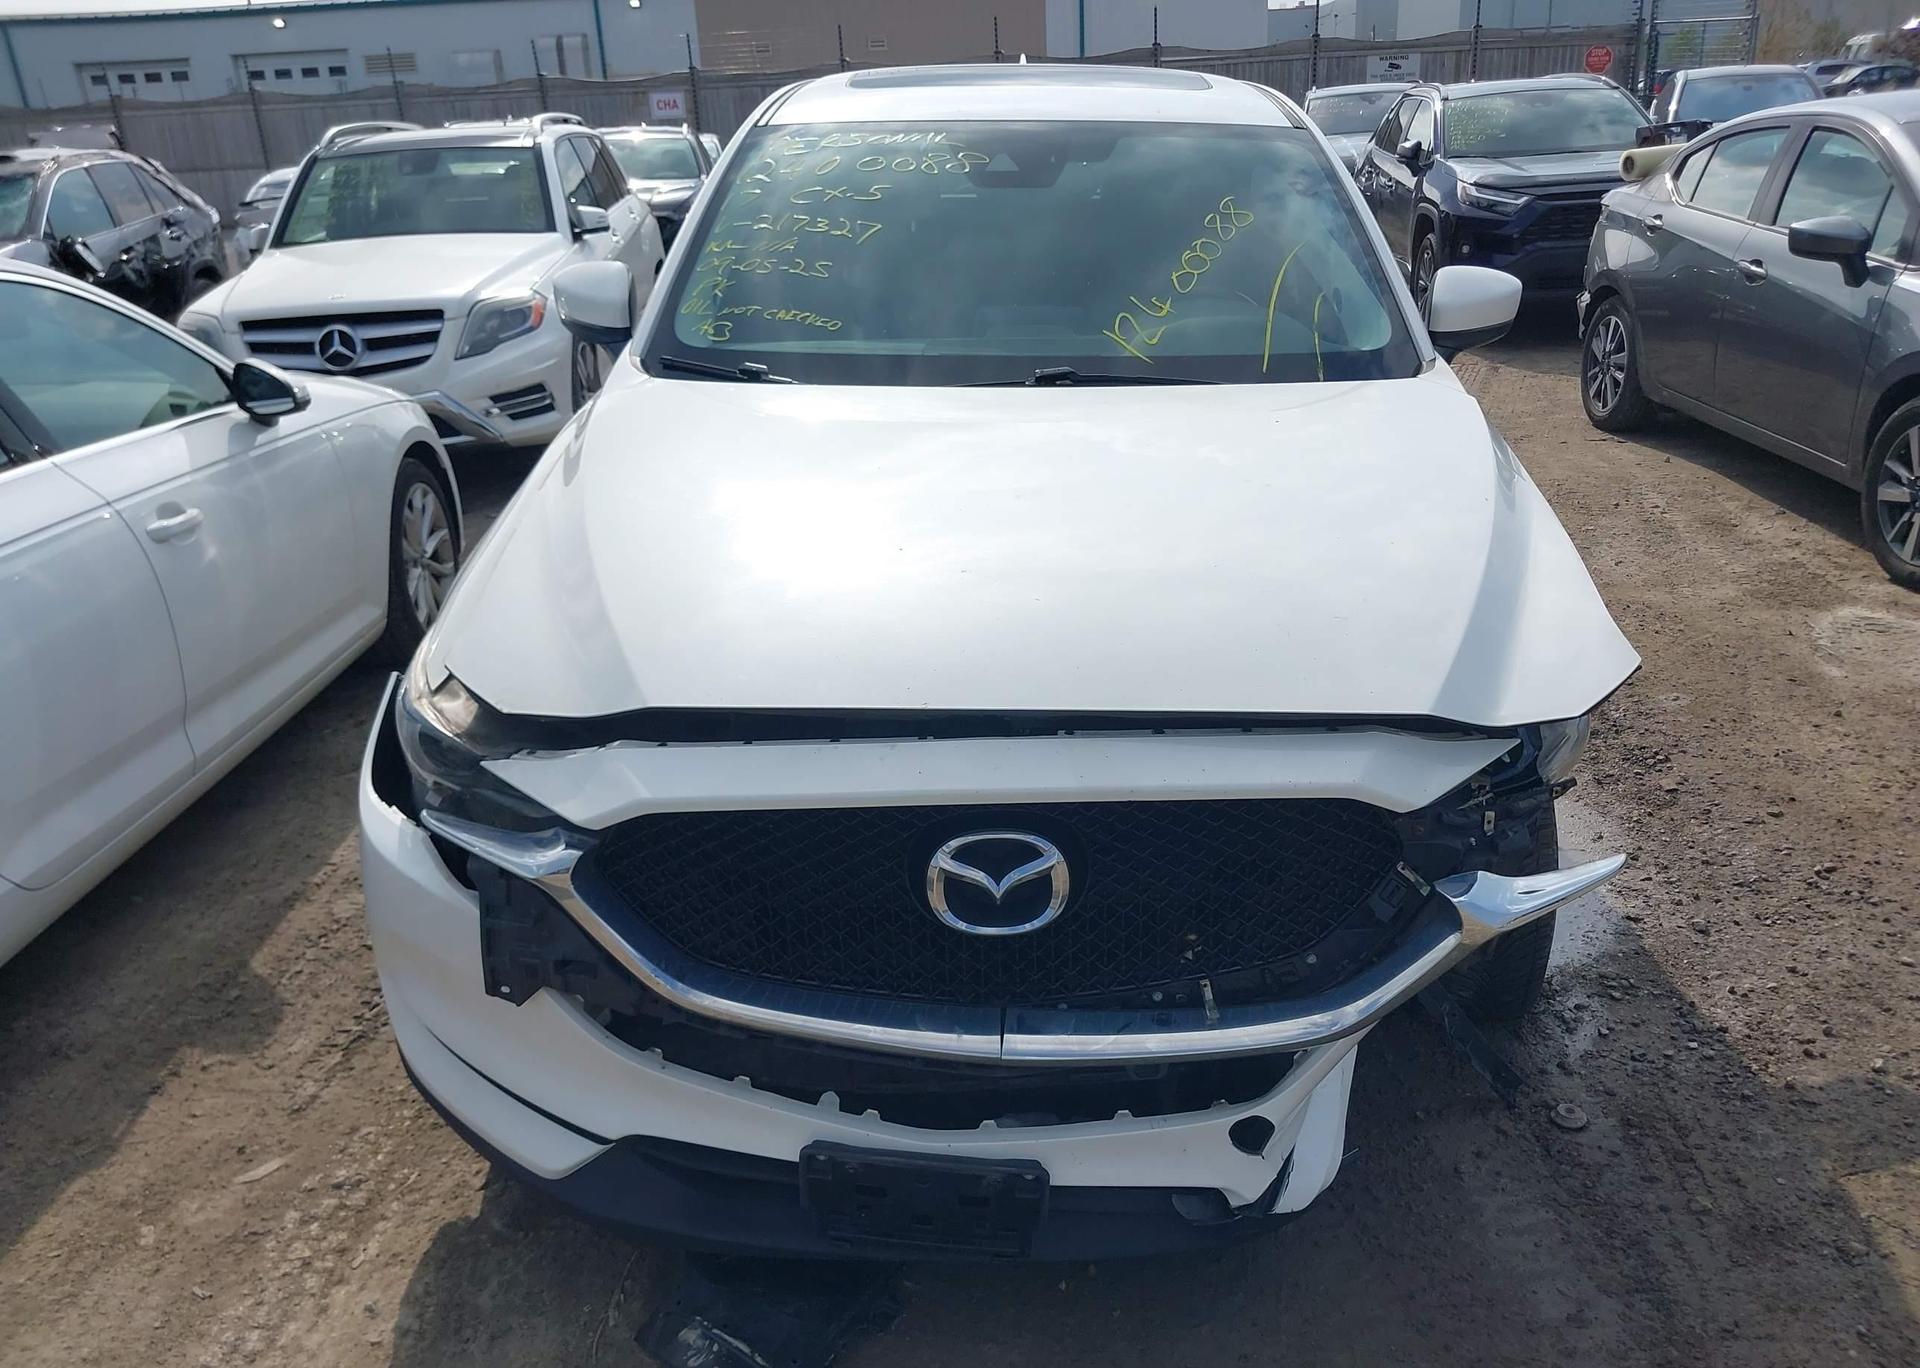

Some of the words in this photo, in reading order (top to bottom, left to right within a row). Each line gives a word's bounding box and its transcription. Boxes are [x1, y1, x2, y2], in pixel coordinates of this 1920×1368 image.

[1379, 54, 1409, 62] WARNING
[656, 98, 680, 111] CHA
[790, 184, 893, 205] CX-5
